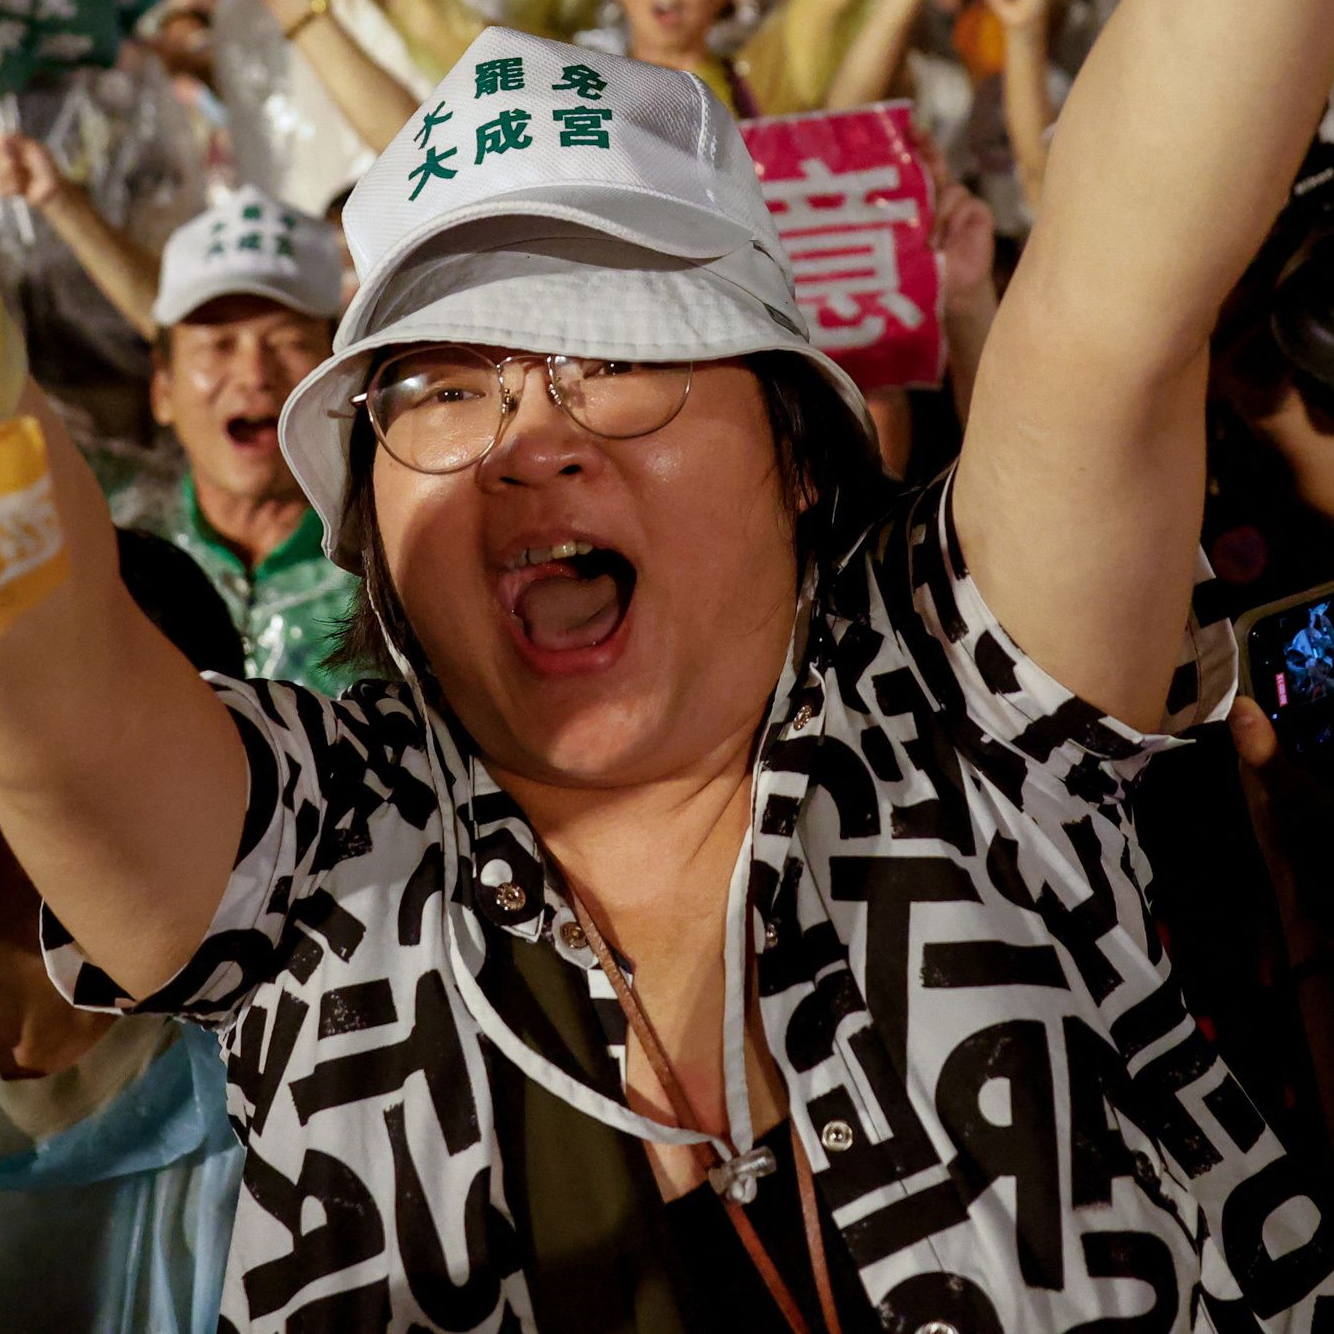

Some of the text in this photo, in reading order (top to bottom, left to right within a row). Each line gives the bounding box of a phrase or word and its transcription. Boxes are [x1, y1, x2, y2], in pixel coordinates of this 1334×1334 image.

[413, 57, 608, 150] 大罷免
[408, 106, 613, 202] 大成宮
